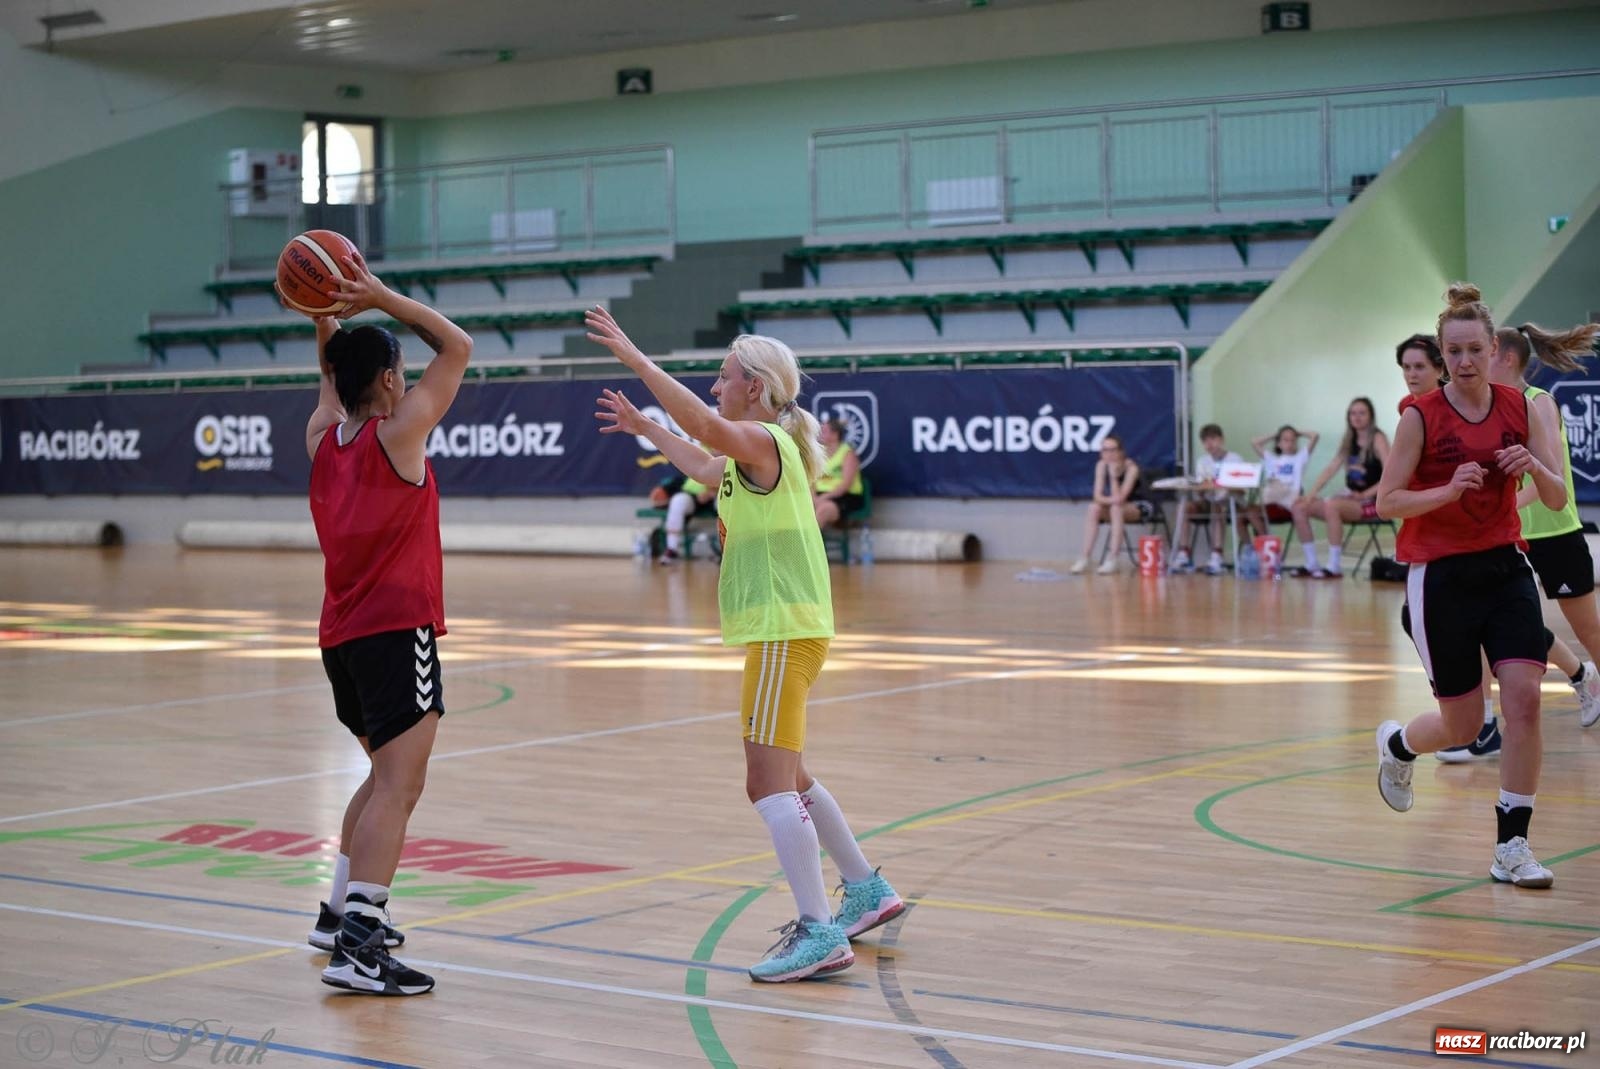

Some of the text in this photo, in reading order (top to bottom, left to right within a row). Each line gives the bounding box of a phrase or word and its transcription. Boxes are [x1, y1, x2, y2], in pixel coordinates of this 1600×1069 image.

[1280, 11, 1302, 28] B
[623, 77, 647, 92] A
[287, 247, 324, 285] molten
[19, 420, 141, 460] RACIBÓRZ
[426, 412, 565, 457] ACIBÓRZ
[912, 404, 1116, 453] RACIBÓRZ
[719, 471, 733, 500] 5
[1142, 541, 1154, 569] 5
[1262, 540, 1277, 567] 5
